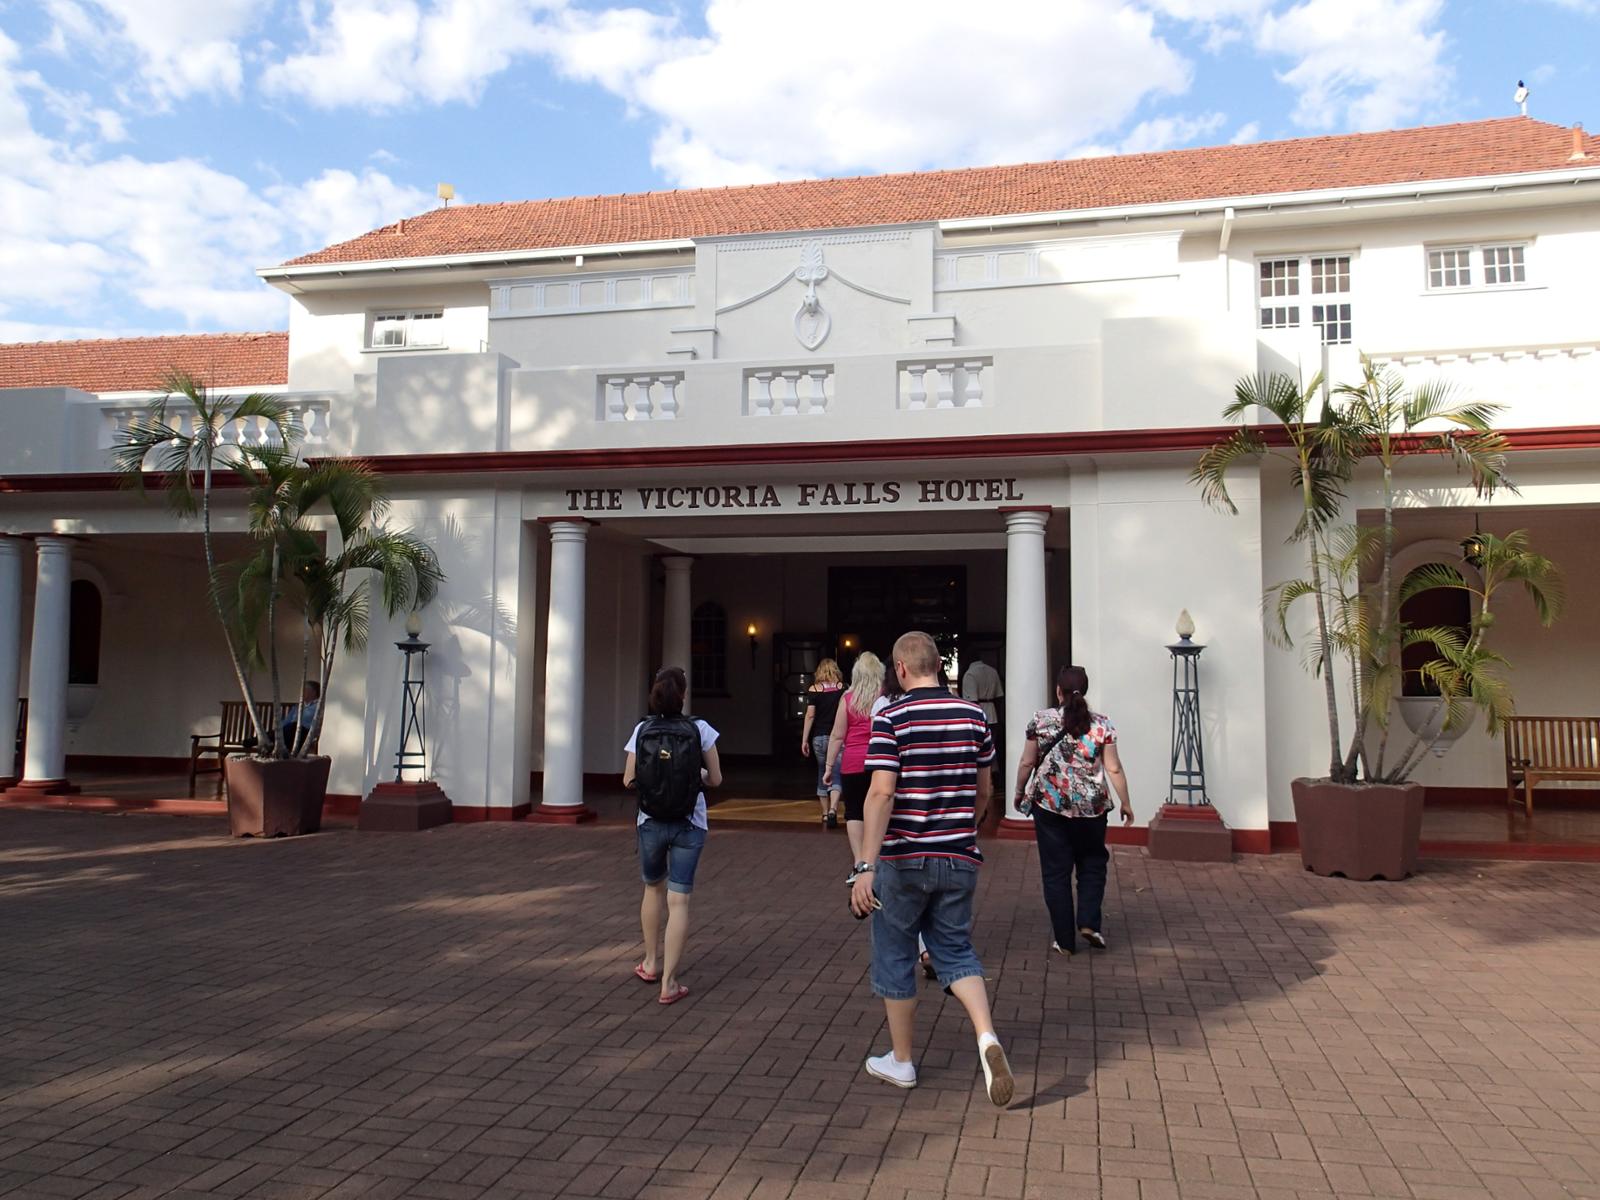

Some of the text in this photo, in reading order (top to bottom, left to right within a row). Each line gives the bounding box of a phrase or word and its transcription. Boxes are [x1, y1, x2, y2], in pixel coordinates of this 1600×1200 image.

[566, 478, 1024, 511] THE VICTORIA FALLS HOTEL
